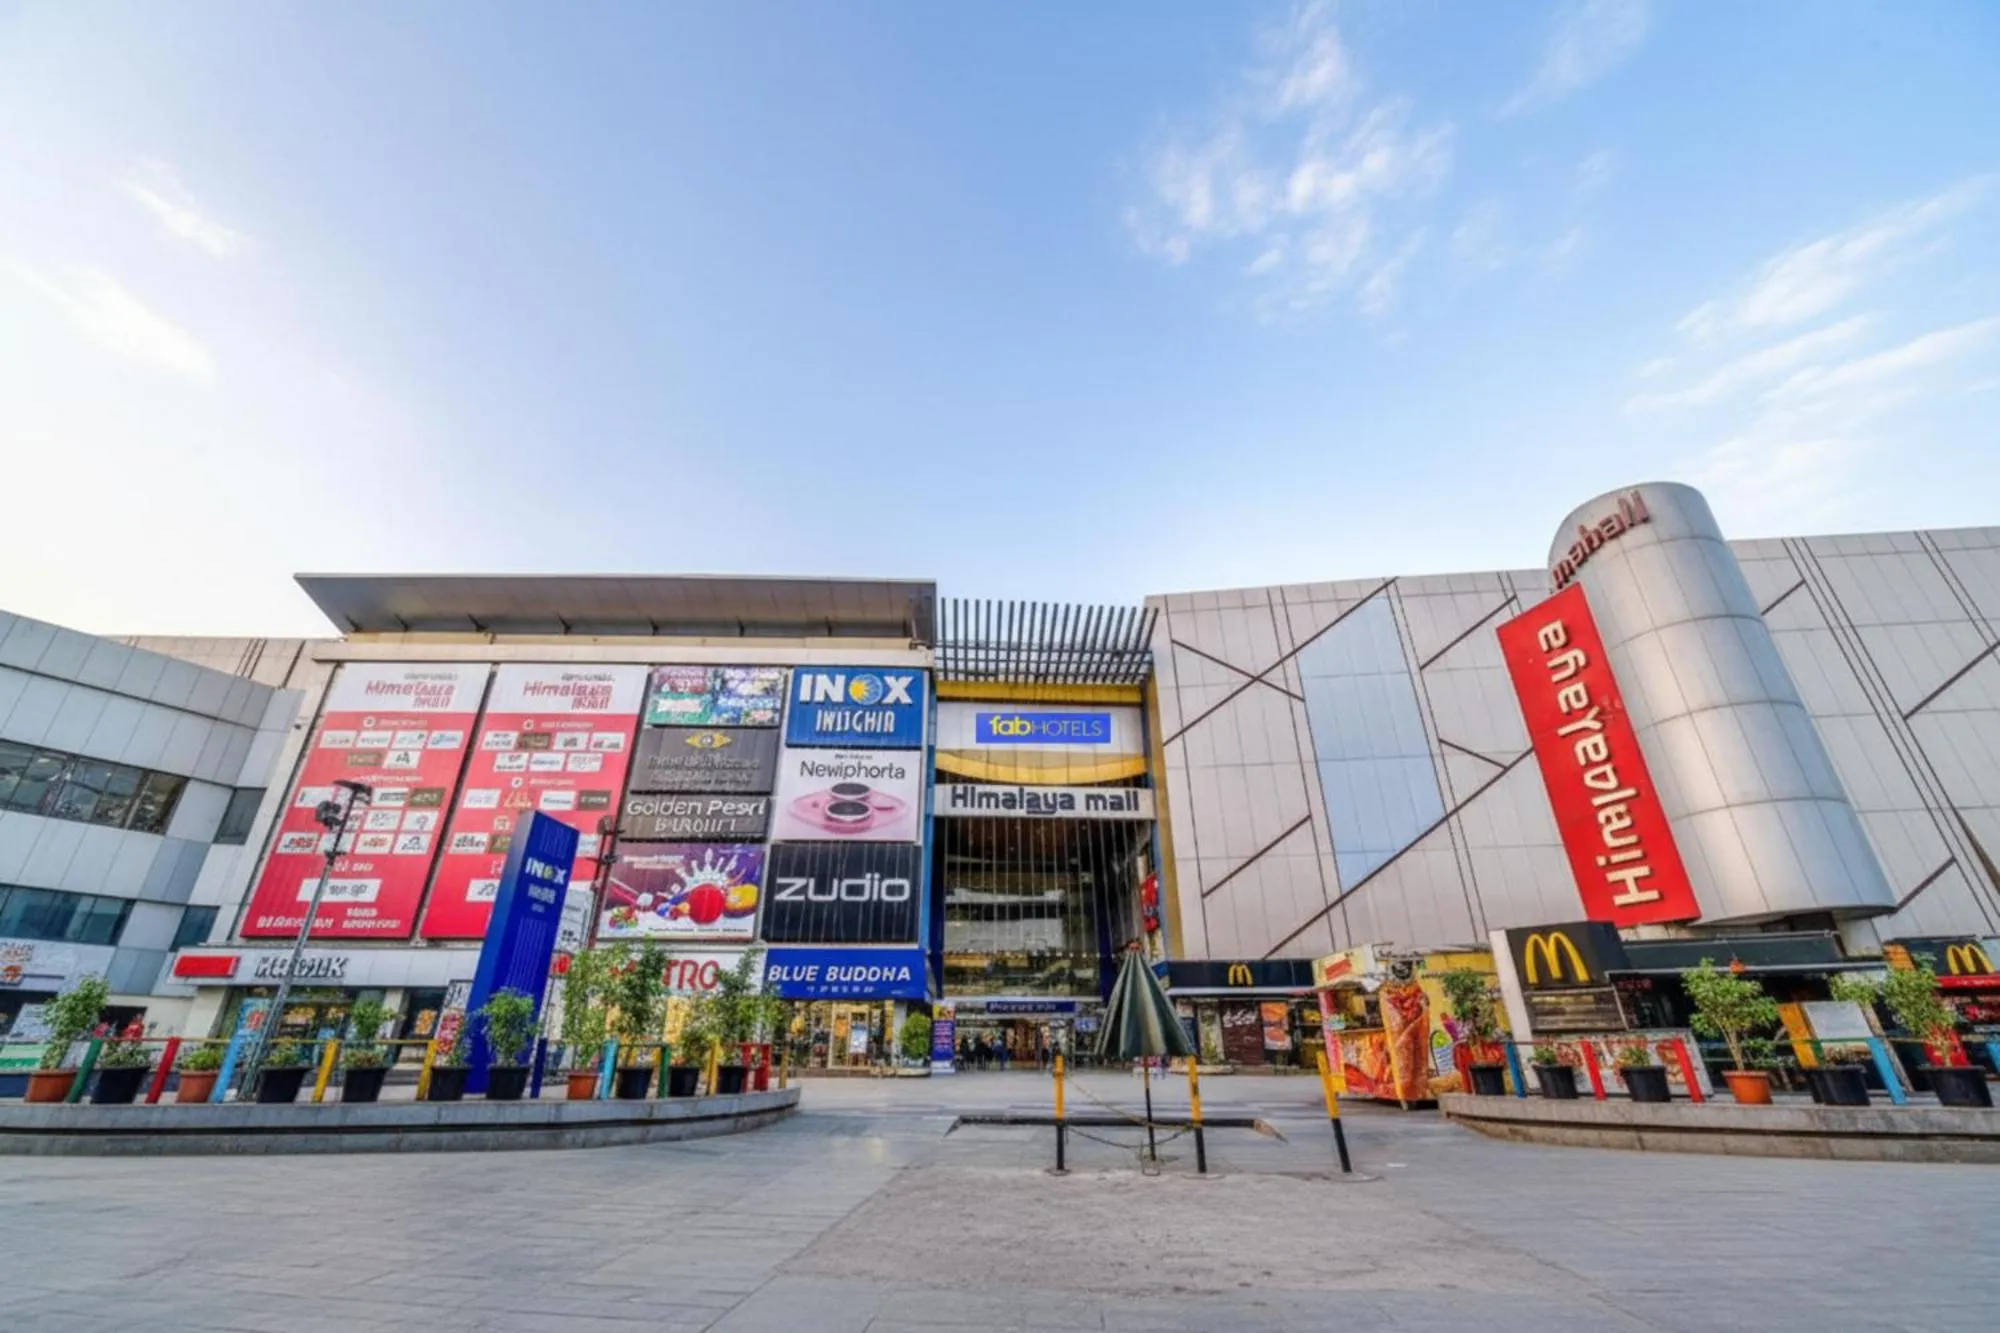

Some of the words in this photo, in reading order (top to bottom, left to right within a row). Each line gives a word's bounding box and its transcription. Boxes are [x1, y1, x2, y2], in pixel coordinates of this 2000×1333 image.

[799, 673, 914, 706] INOX
[767, 964, 819, 982] BLUE
[825, 965, 912, 983] BUDDHA
